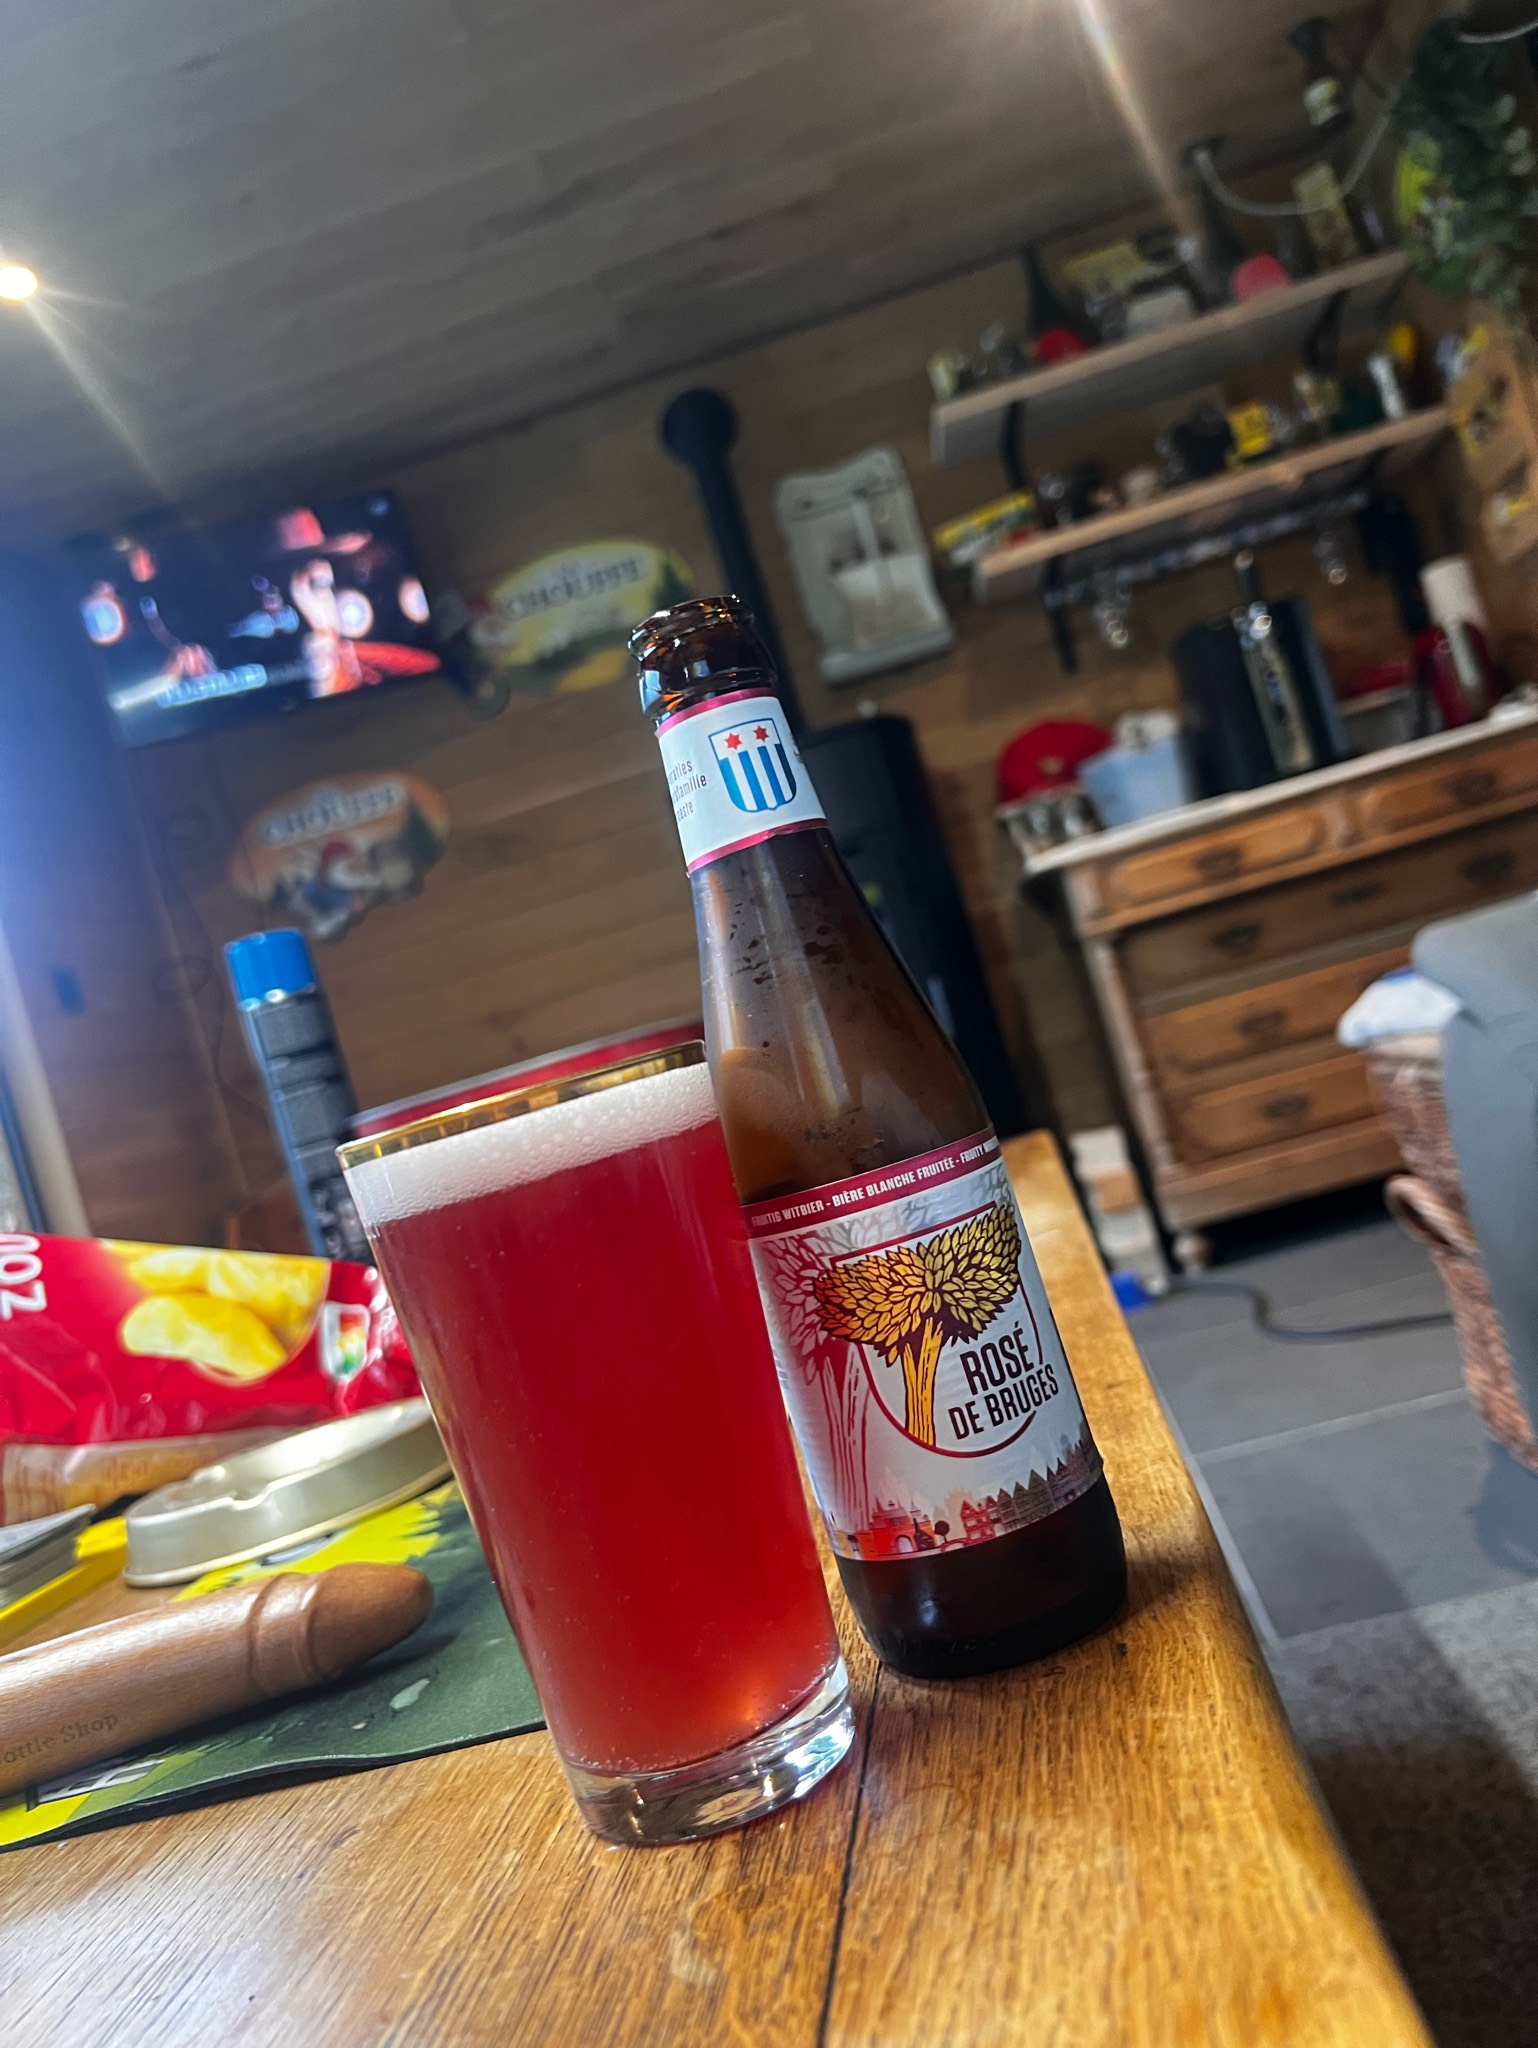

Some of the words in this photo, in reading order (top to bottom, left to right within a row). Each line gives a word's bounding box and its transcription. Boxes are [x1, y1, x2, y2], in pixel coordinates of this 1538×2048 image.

[781, 1200, 825, 1220] WITBIER
[832, 1187, 866, 1207] BIÈRE
[865, 1171, 917, 1197] BLANCHE
[916, 1156, 956, 1180] FRUITÉE
[959, 1320, 1035, 1396] ROSÉ
[948, 1400, 985, 1440] DE
[984, 1363, 1060, 1428] BRUGES
[0, 1735, 57, 1765] ottle
[60, 1715, 119, 1744] Shop
